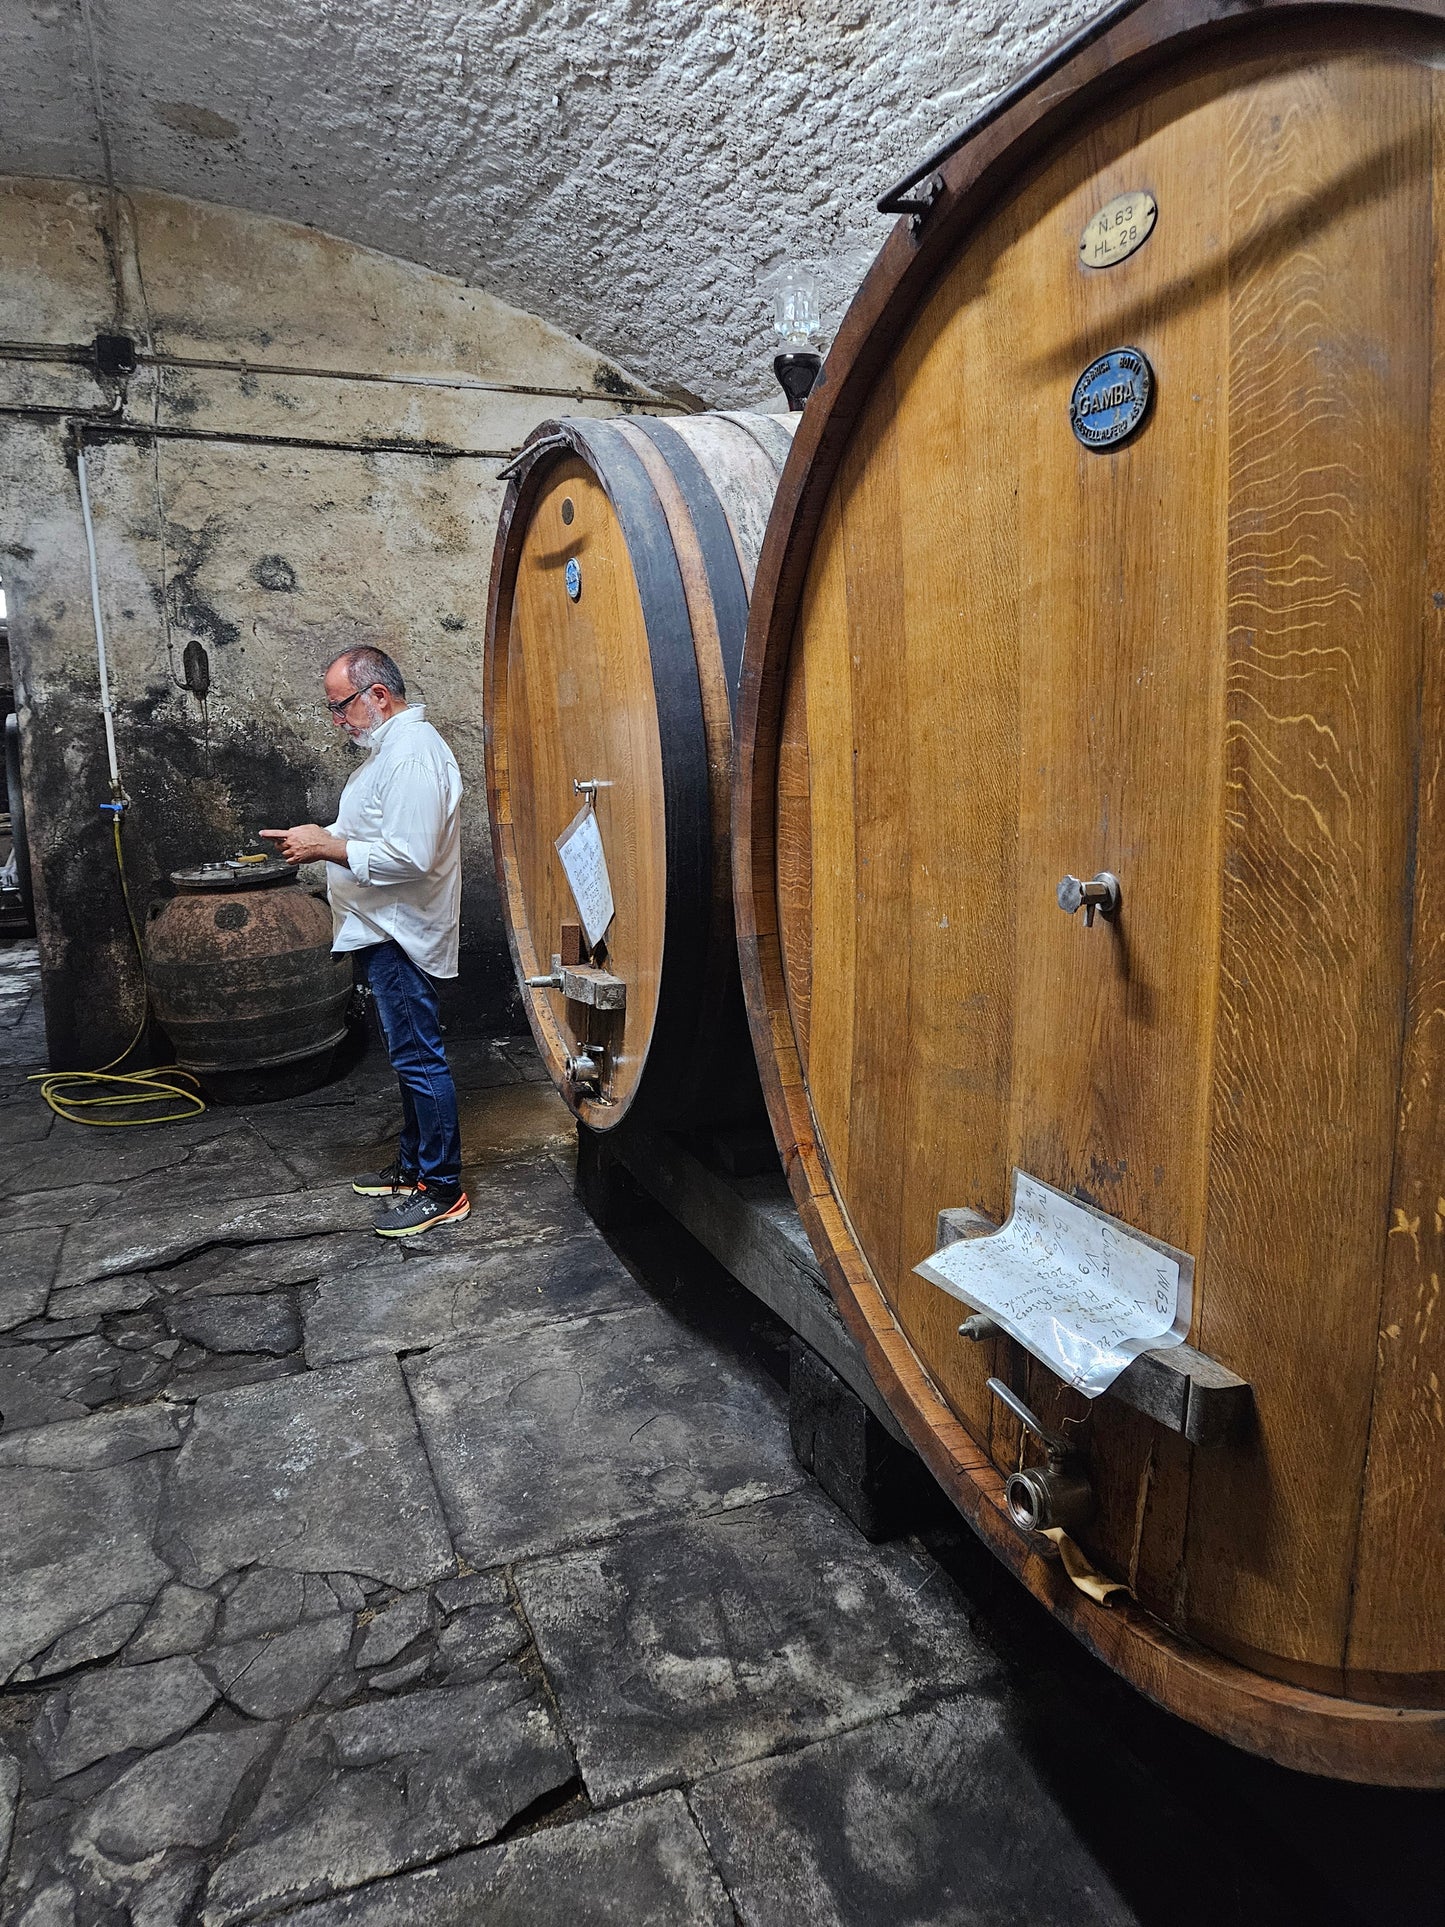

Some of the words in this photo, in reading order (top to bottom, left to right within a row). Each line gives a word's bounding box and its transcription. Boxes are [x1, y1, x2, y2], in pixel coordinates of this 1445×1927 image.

[1115, 206, 1133, 226] 63
[1119, 225, 1138, 247] 28
[1080, 380, 1137, 417] GAMBA
